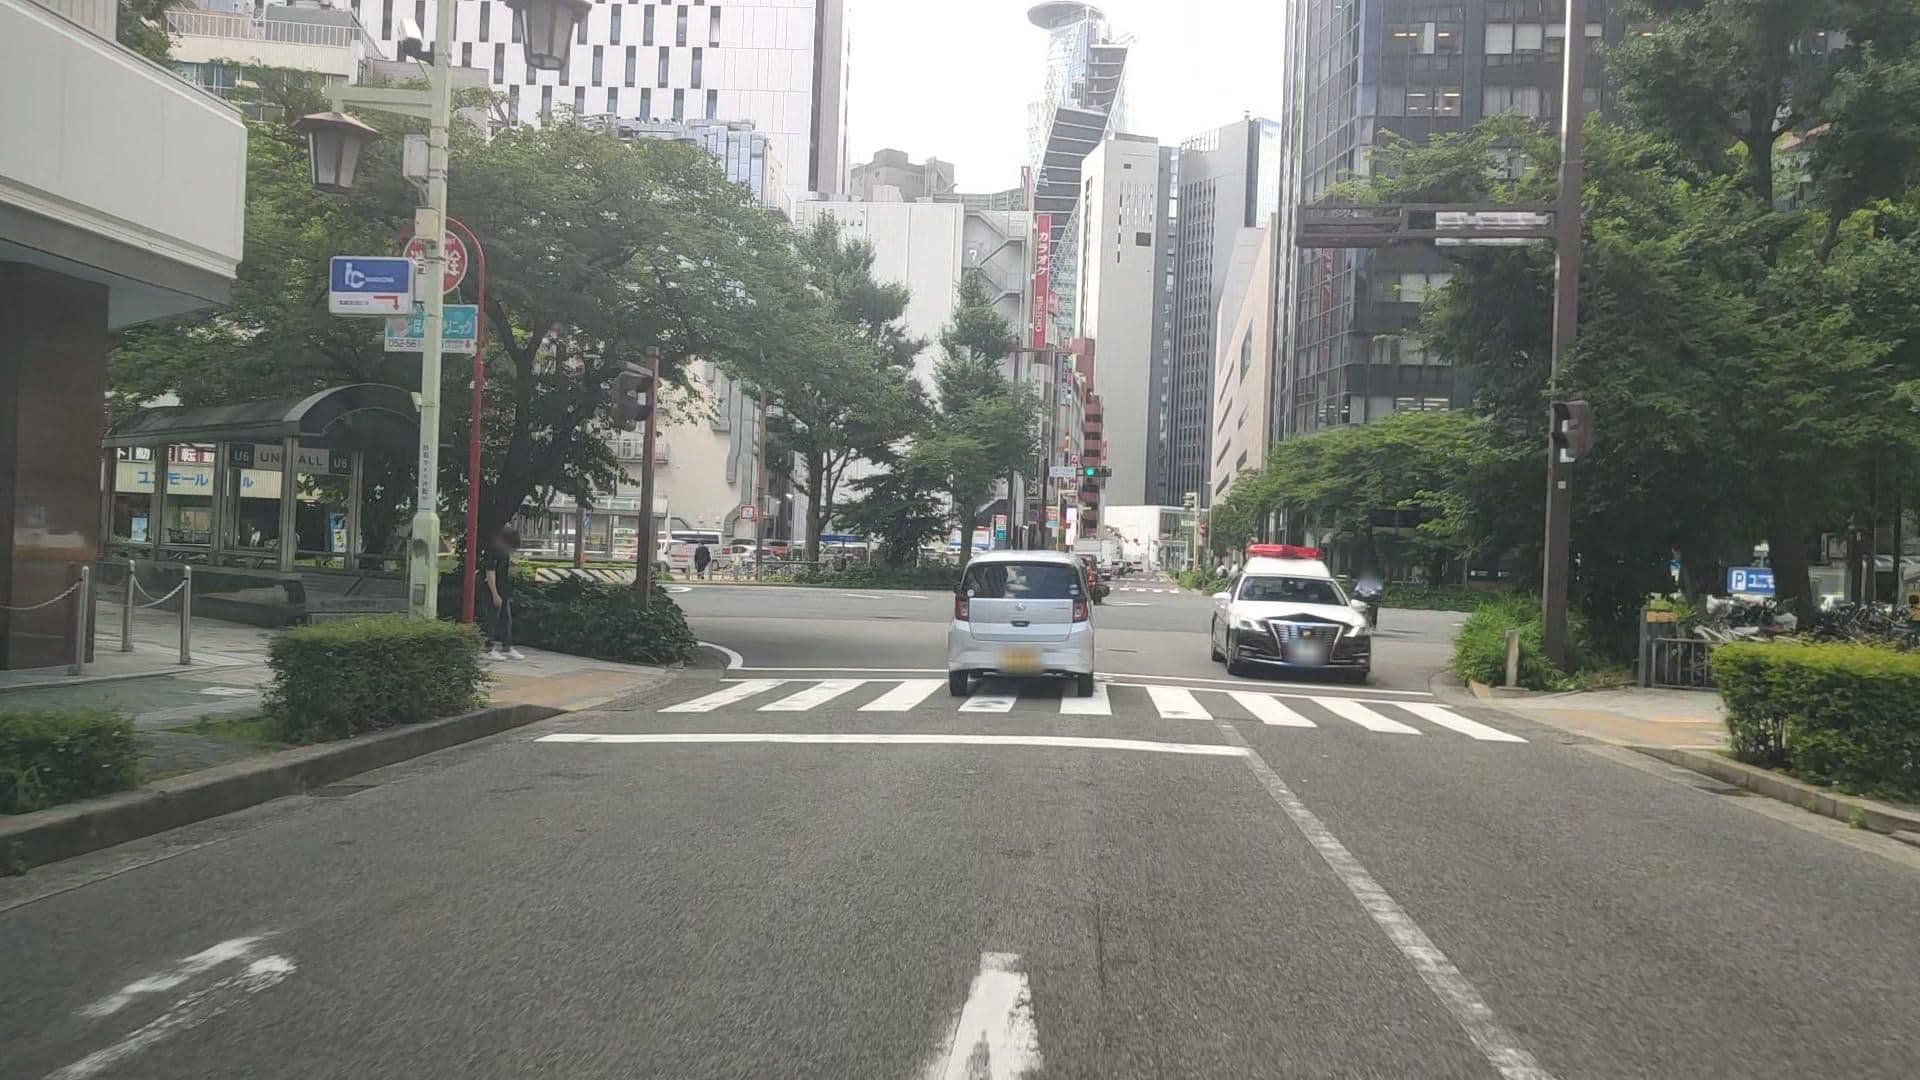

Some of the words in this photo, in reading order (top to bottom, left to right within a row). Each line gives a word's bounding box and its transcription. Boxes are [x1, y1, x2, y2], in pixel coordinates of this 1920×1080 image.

[1036, 231, 1049, 276] カラオケ
[410, 250, 461, 276] 消栓
[234, 451, 249, 462] U6
[260, 452, 324, 466] UNALL
[334, 457, 347, 468] U6
[137, 471, 208, 487] ユモール
[1736, 572, 1744, 588] P
